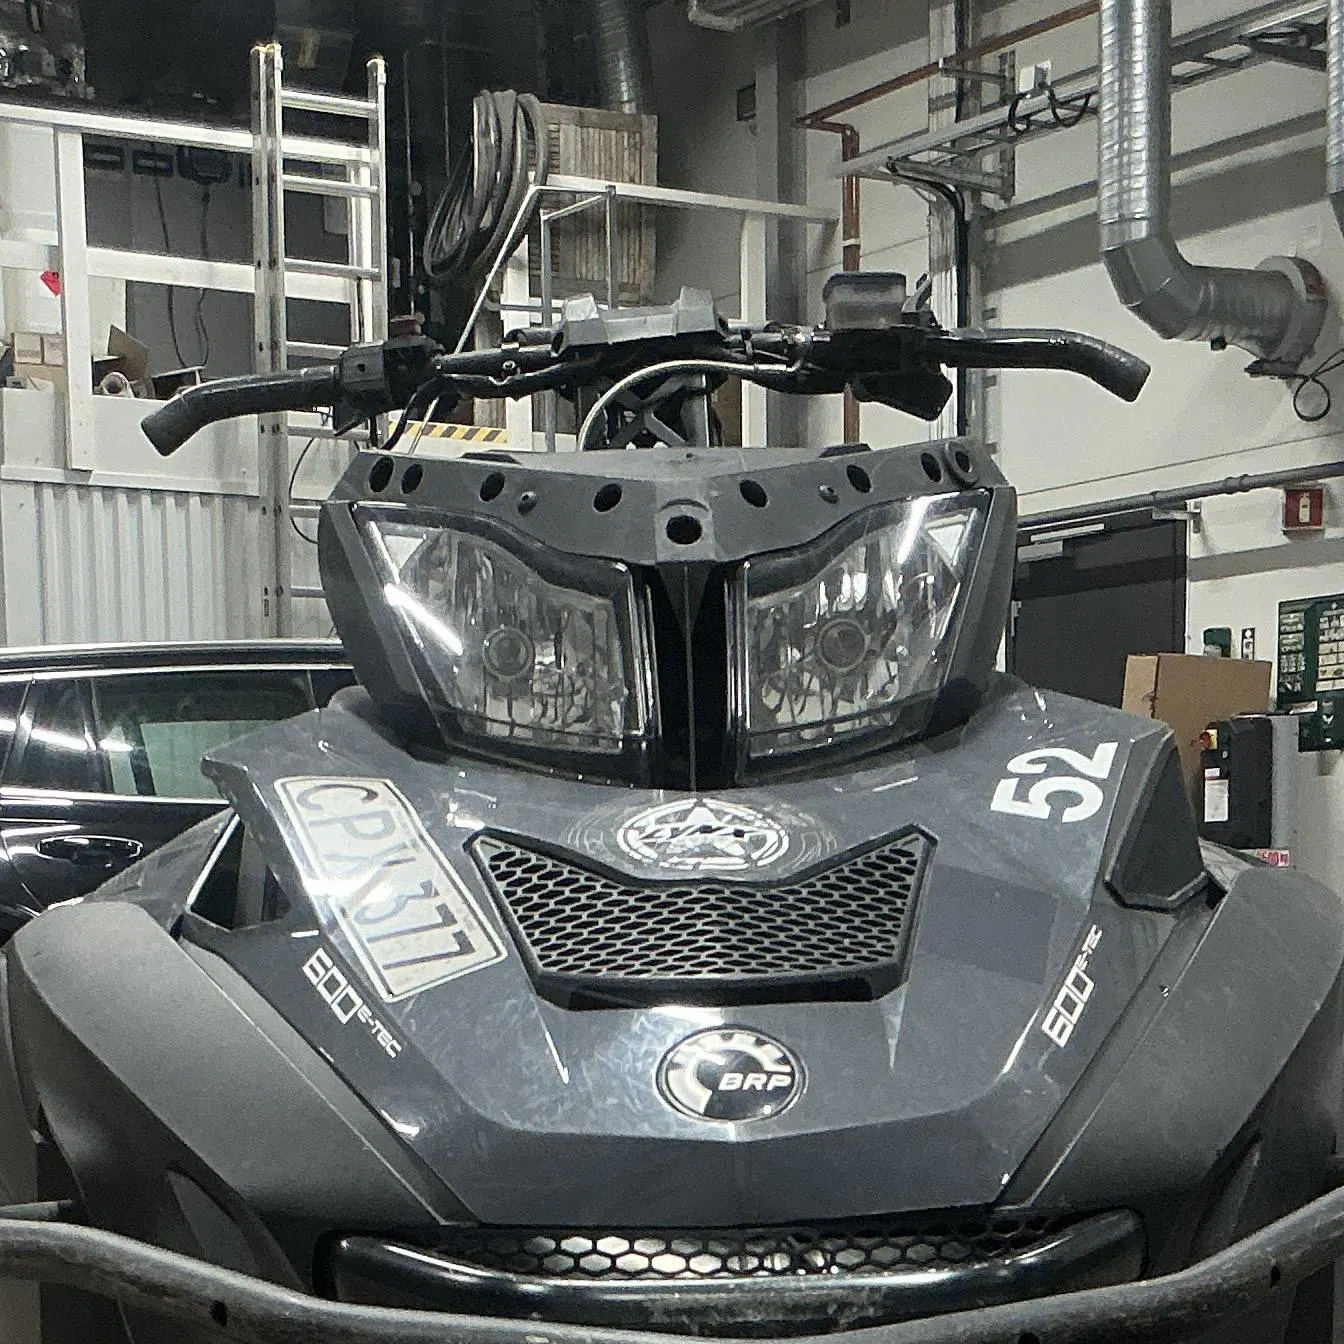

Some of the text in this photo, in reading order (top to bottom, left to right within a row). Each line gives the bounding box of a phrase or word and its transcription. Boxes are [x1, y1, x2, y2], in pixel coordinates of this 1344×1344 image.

[990, 741, 1119, 823] 52
[302, 947, 402, 1058] 600 E-TEC
[1041, 965, 1095, 1048] 600
[717, 1072, 792, 1091] BRP
